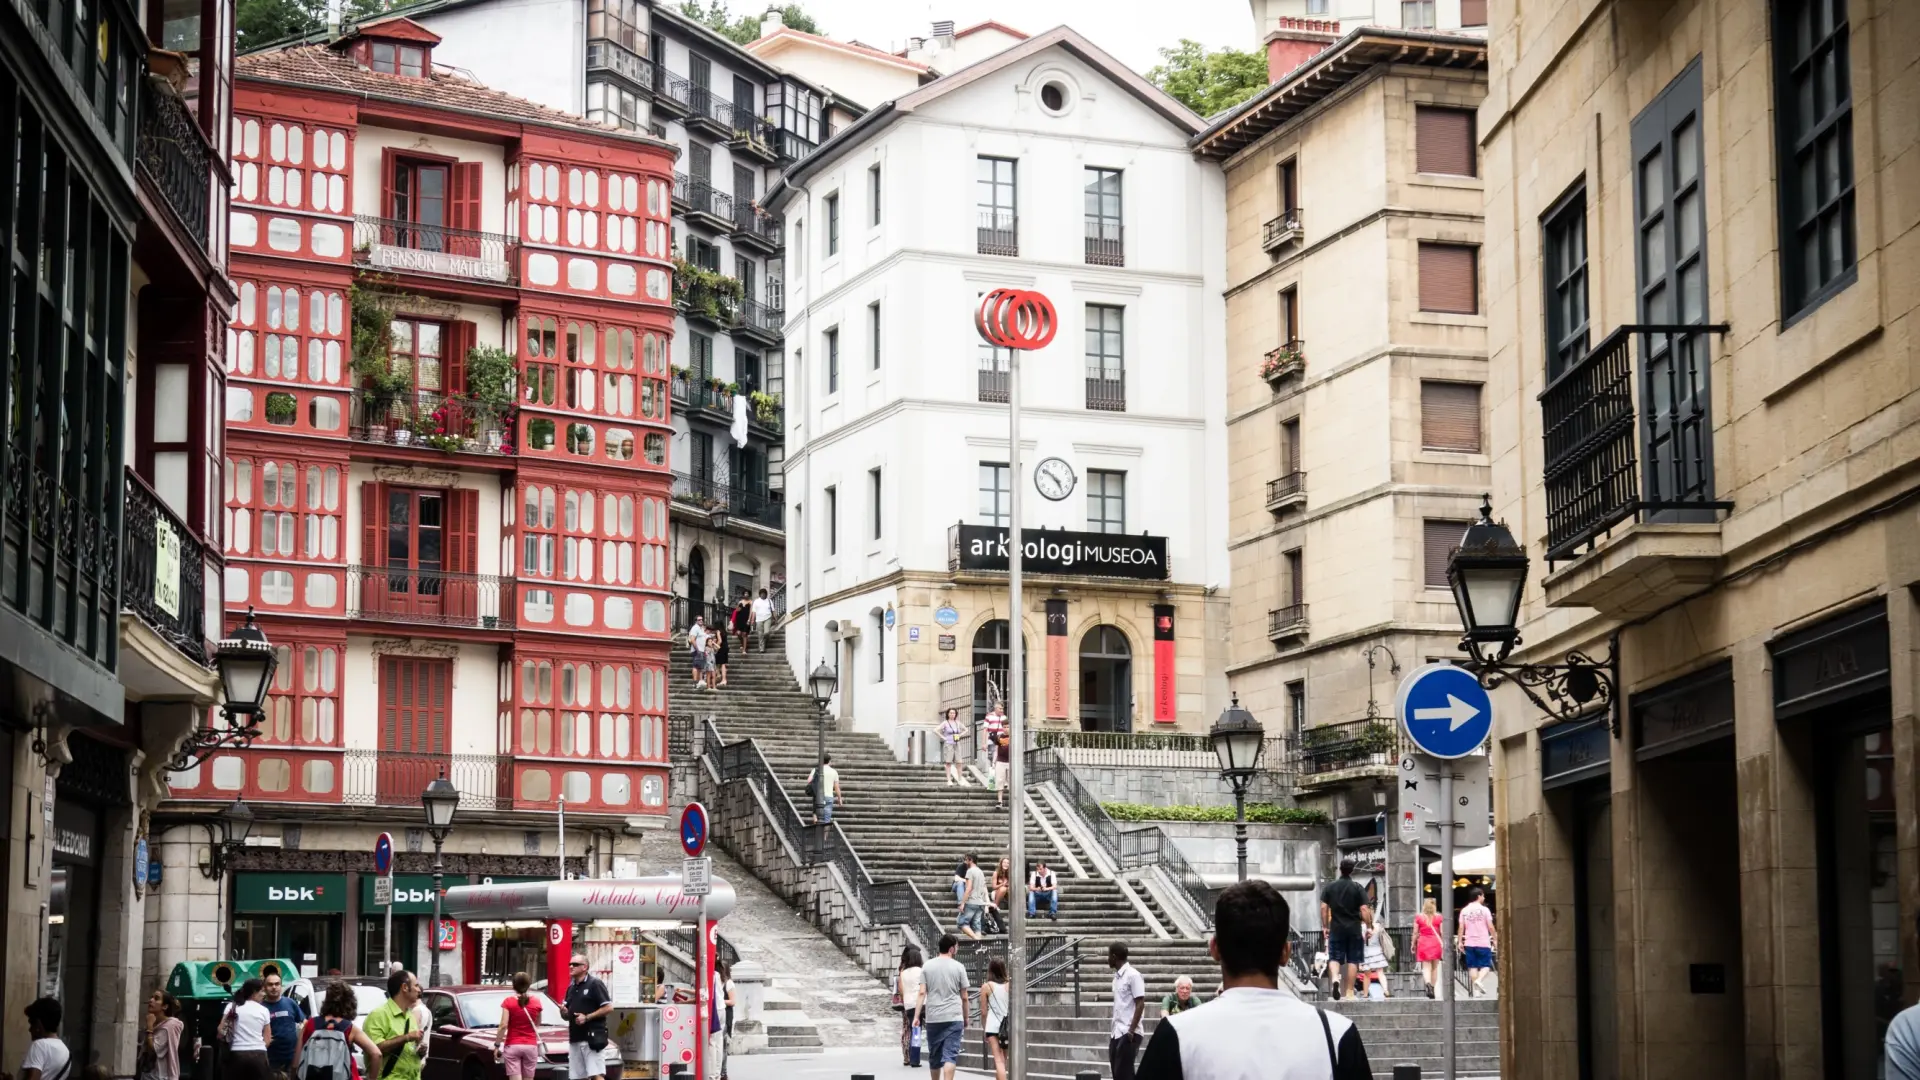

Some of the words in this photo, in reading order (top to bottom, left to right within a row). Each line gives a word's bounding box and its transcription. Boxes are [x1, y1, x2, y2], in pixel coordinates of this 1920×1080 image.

[382, 249, 436, 271] PENSION
[970, 532, 1082, 566] arkologi
[1084, 545, 1158, 566] MUSEOA
[1052, 668, 1062, 712] arkeologi
[53, 827, 91, 859] ALZEDONIA
[269, 886, 314, 901] bbk
[394, 888, 435, 902] bbk
[582, 886, 647, 906] Helados
[552, 928, 560, 940] B
